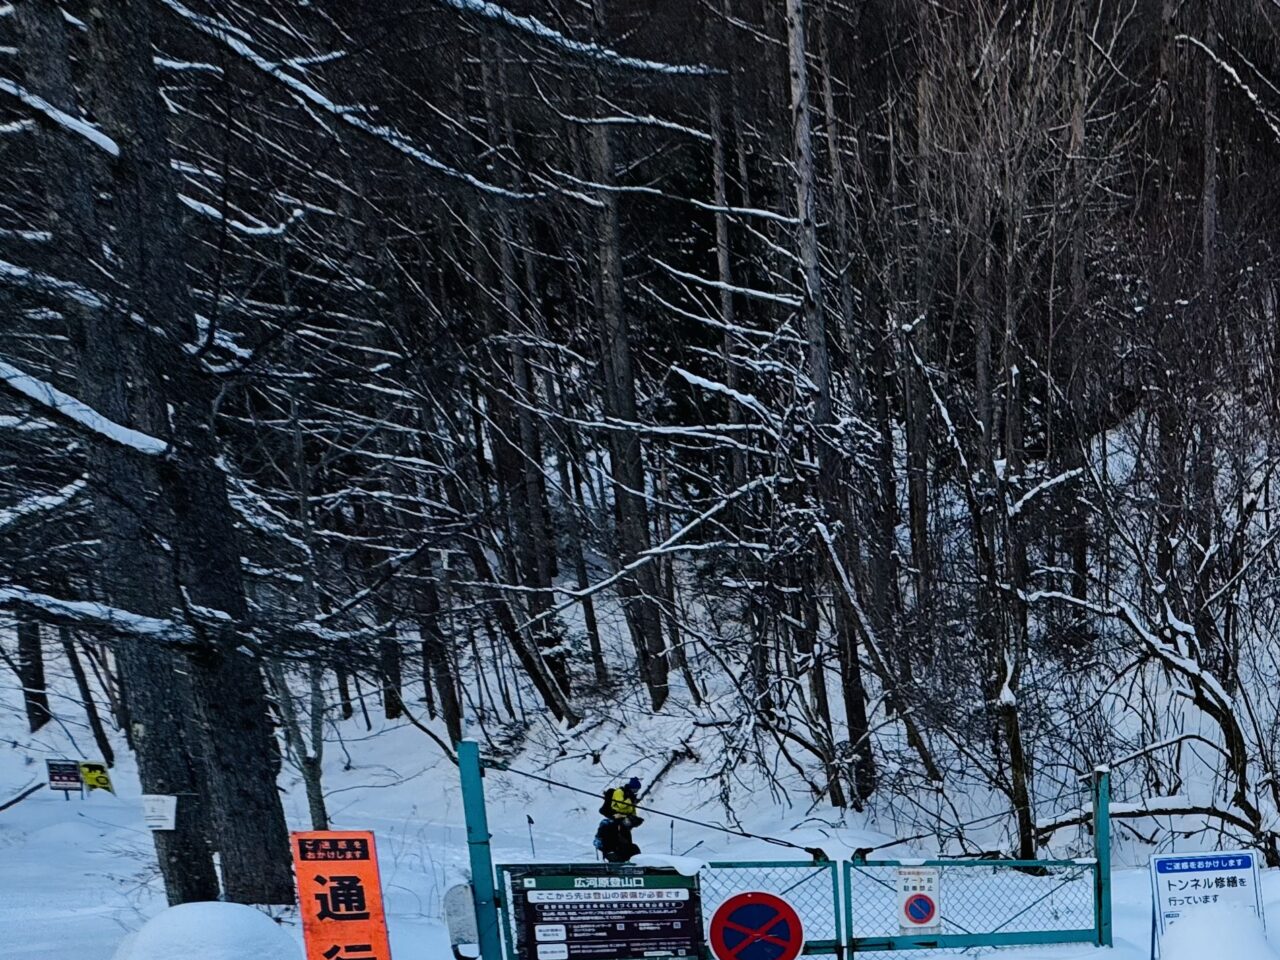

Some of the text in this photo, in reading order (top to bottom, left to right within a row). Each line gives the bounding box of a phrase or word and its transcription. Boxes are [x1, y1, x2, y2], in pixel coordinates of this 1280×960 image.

[306, 851, 361, 859] おかけします
[1165, 858, 1243, 870] ご迷惑をおかけします
[574, 877, 644, 888] 広河原登山口
[1167, 875, 1247, 891] トンネル修繕を
[537, 890, 680, 900] ここから先は登山の装備が必要です
[1168, 894, 1220, 907] 行っています
